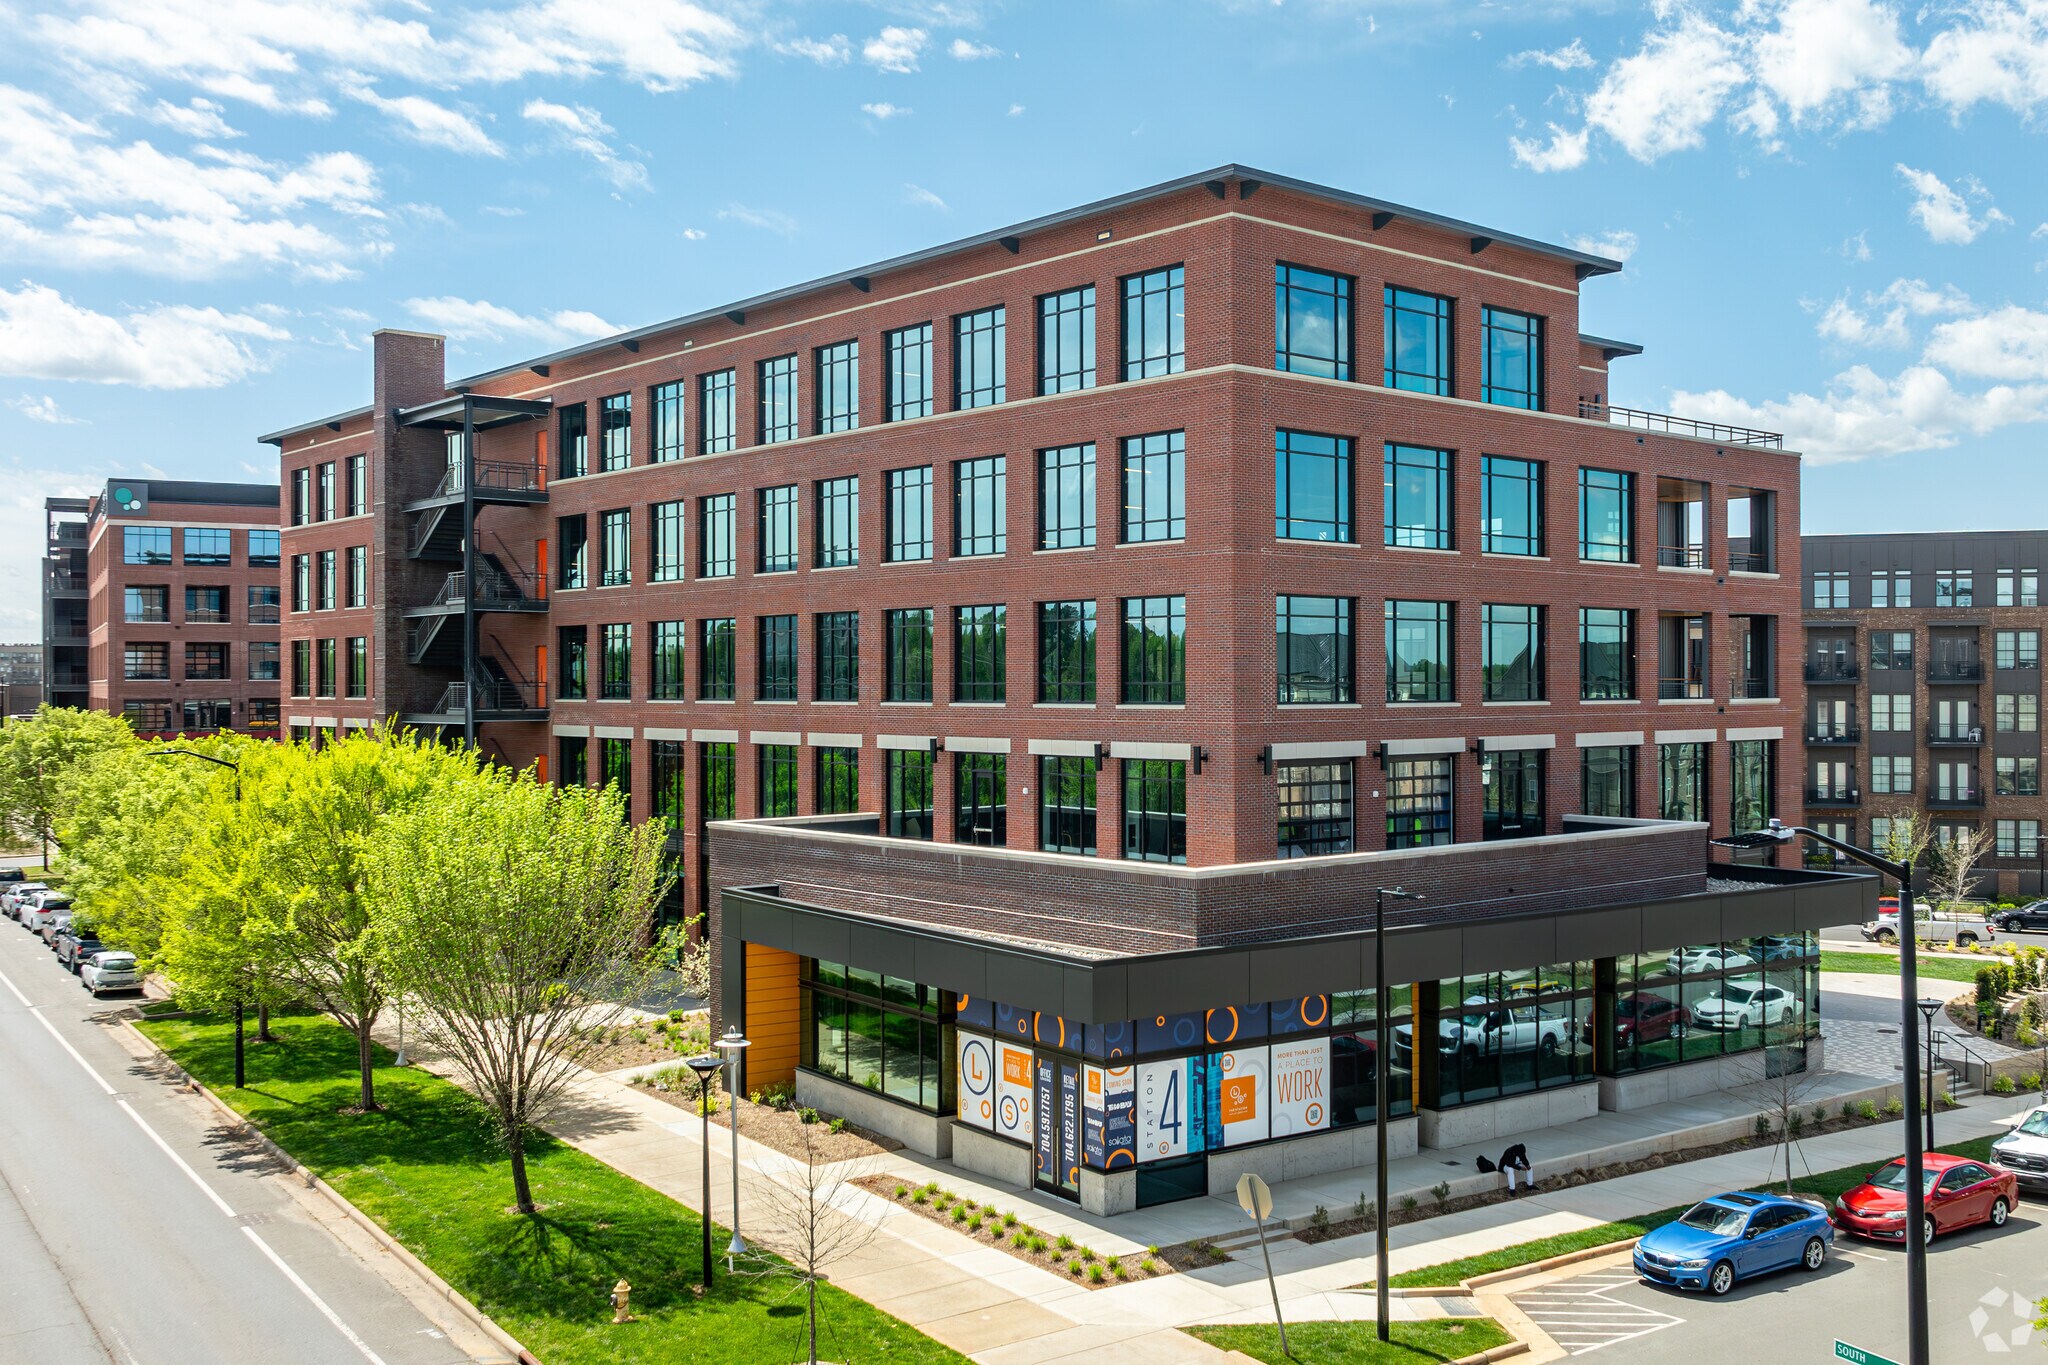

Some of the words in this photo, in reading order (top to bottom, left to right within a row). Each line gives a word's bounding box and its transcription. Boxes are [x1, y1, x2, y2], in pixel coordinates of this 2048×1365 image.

[972, 1053, 982, 1080] L
[1277, 1051, 1293, 1059] MORE
[1294, 1049, 1309, 1057] THAN
[1310, 1047, 1323, 1055] JUST
[1277, 1062, 1283, 1070] A
[1285, 1058, 1310, 1069] PLACE
[1313, 1056, 1323, 1065] TO
[1277, 1067, 1323, 1104] WORK
[1005, 1104, 1013, 1120] S
[1041, 1087, 1050, 1152] 704.597.7757
[1160, 1069, 1182, 1145] 4
[1065, 1093, 1074, 1161] 704.622.1795
[1837, 1344, 1866, 1363] SOUTH
